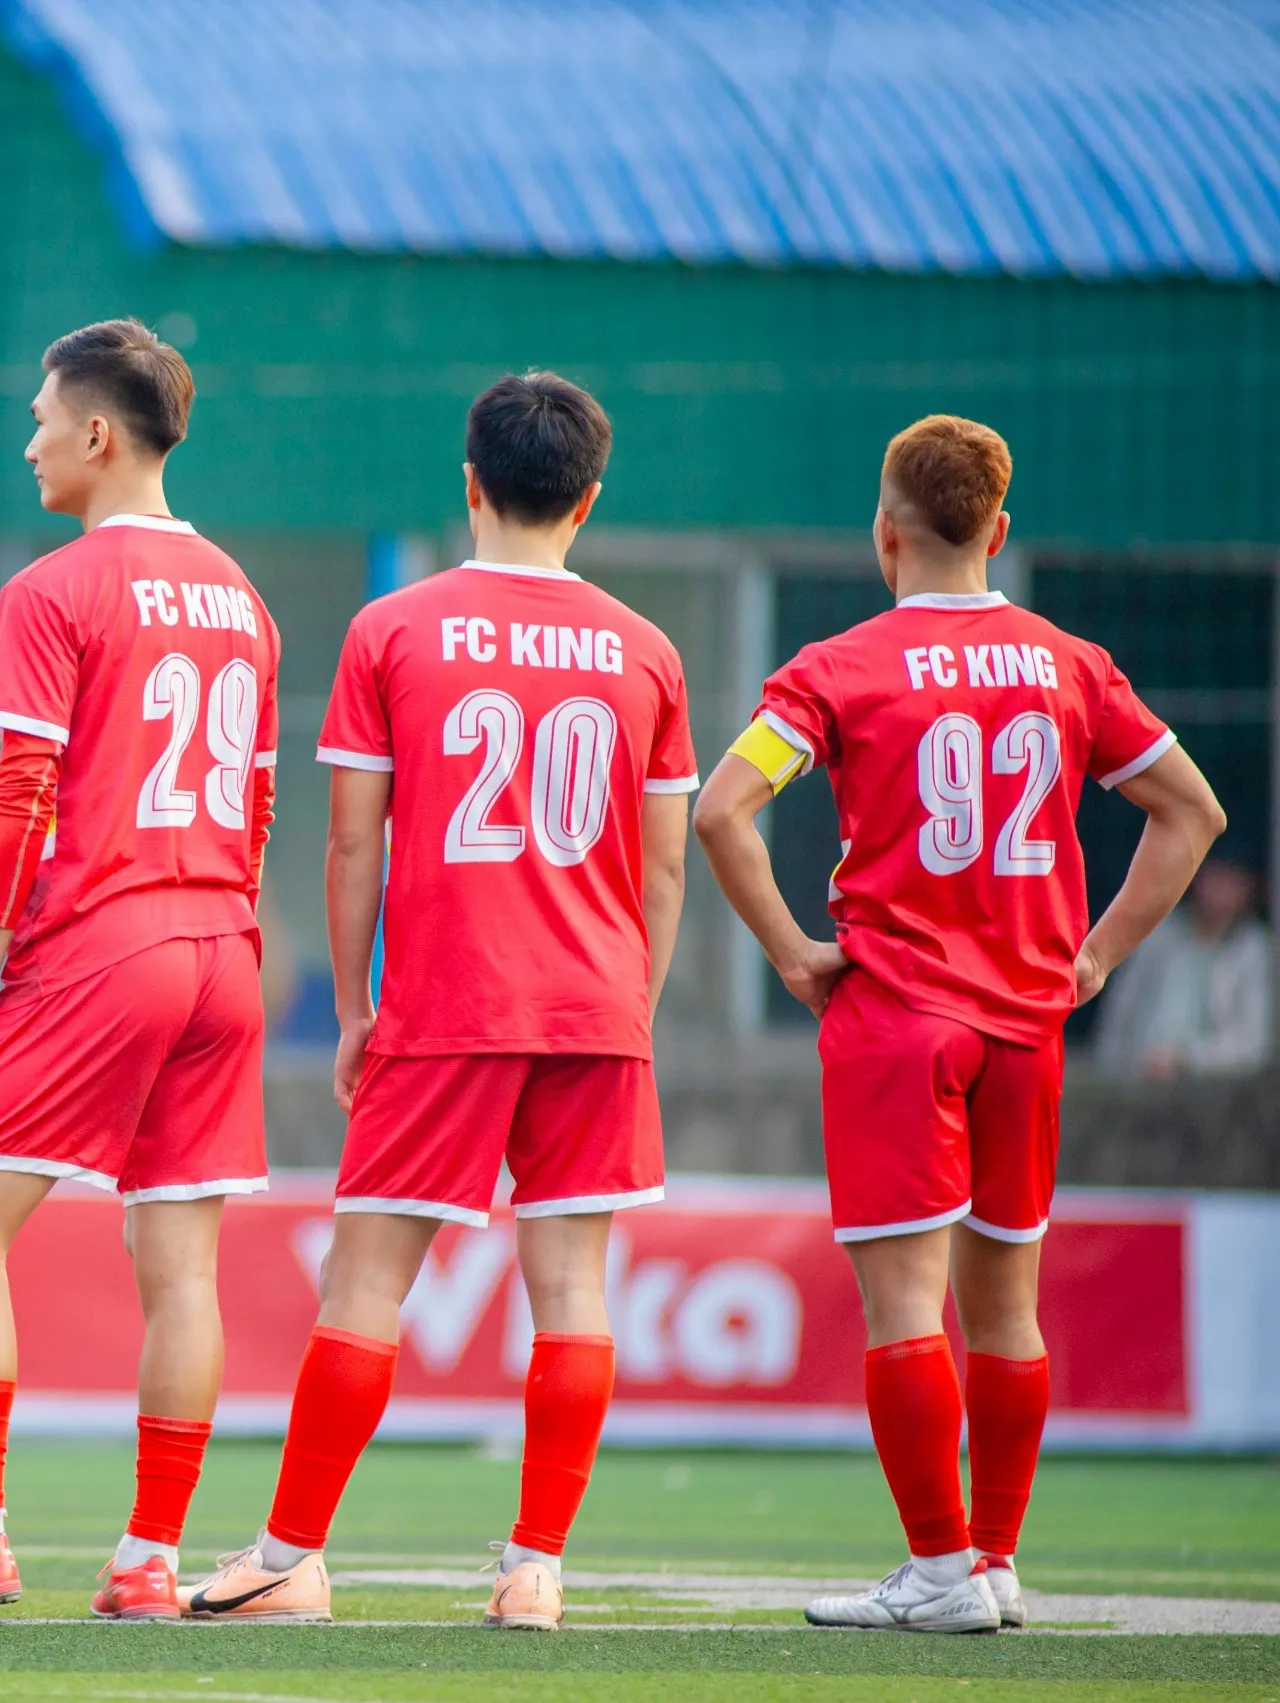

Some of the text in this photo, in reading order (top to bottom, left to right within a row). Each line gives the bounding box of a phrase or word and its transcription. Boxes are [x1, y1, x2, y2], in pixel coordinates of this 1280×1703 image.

[131, 579, 258, 639] FC KING
[441, 616, 623, 675] FC KING
[904, 643, 1059, 690] FC KING
[136, 652, 258, 830] 29
[443, 688, 618, 868] 20
[918, 710, 1061, 876] 92
